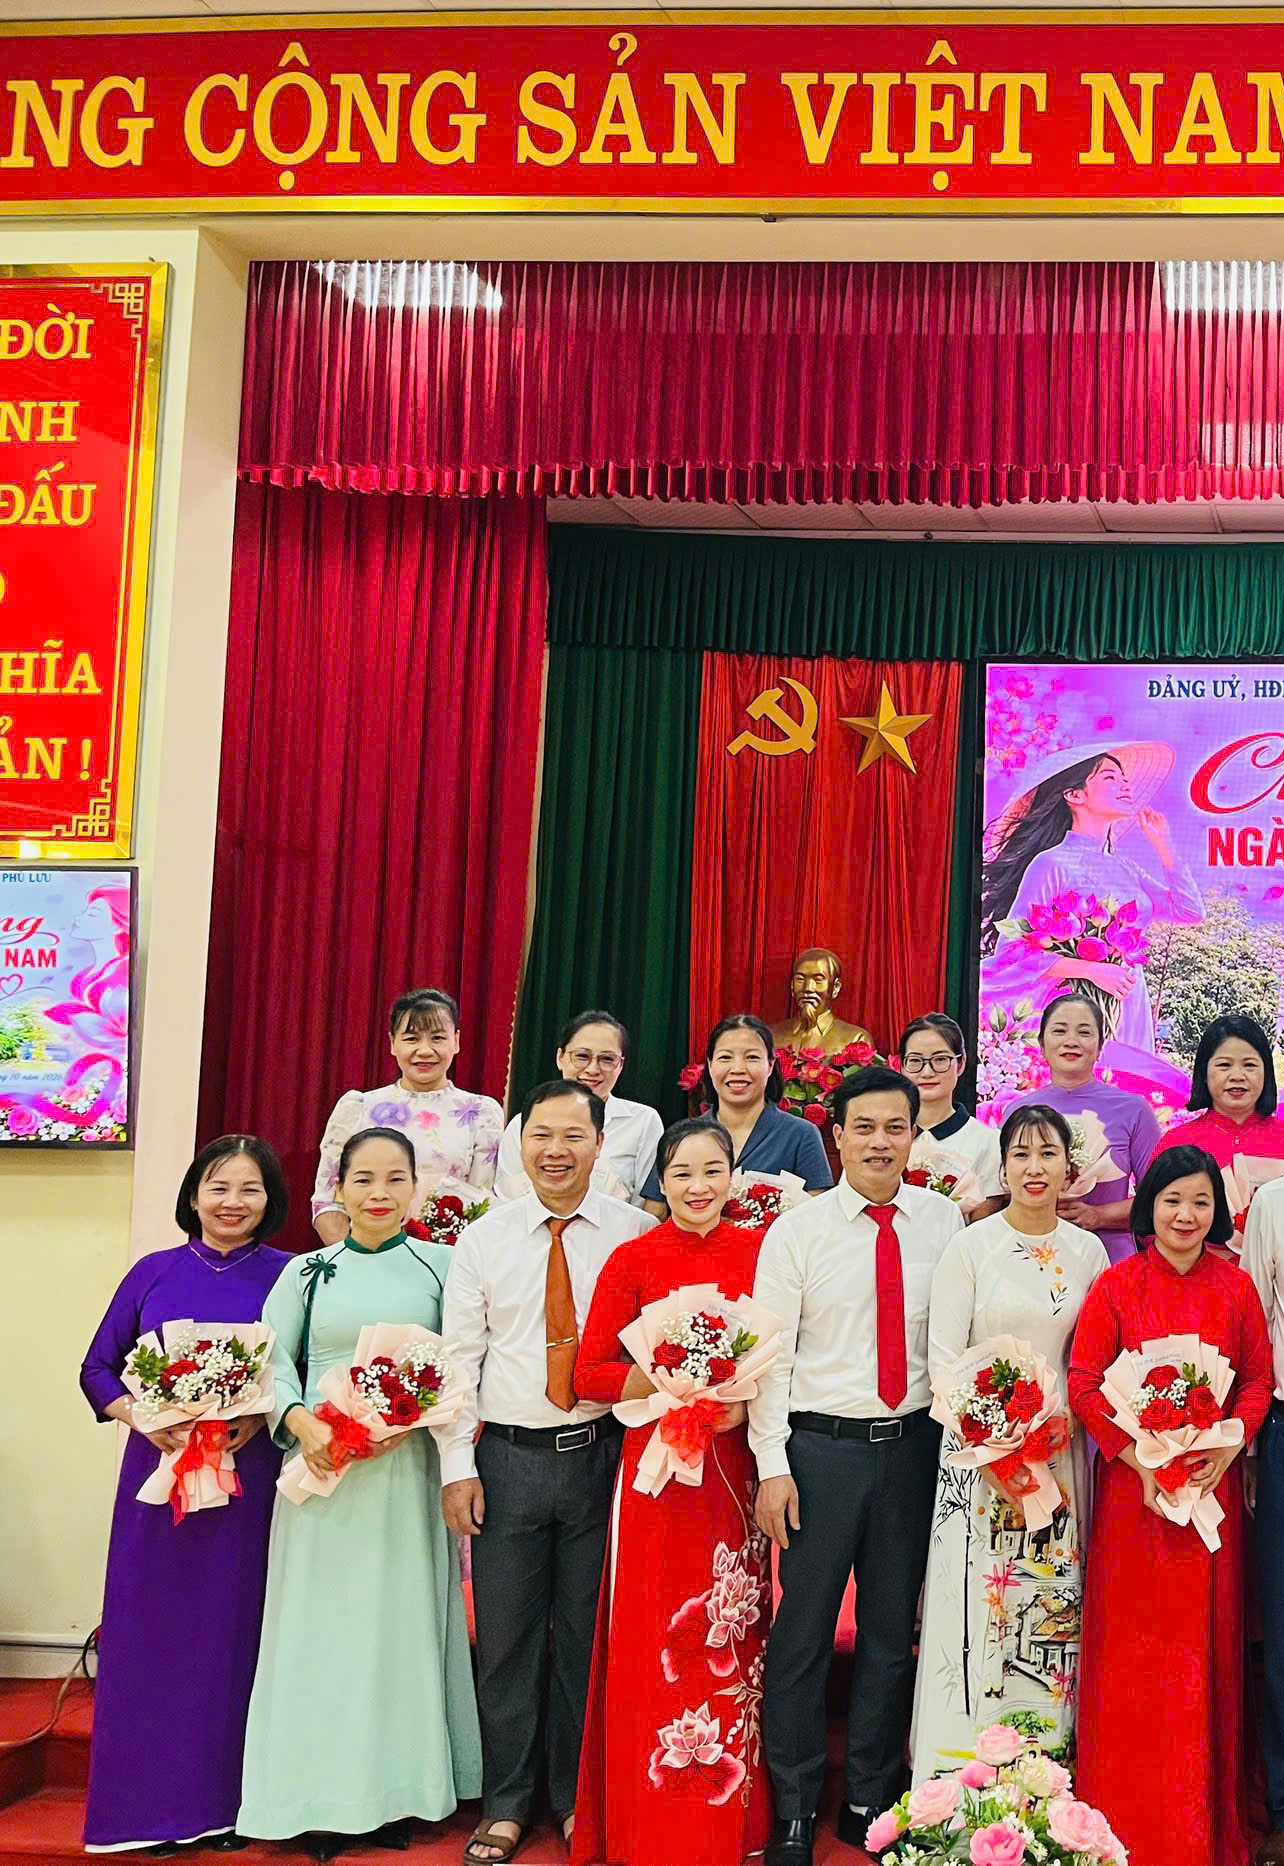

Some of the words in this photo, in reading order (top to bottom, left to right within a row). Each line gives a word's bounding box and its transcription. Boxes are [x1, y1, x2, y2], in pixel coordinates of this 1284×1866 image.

[184, 43, 487, 191] CỘNG
[517, 33, 747, 166] SẢN
[781, 40, 1047, 191] VIỆT
[0, 303, 94, 360] ĐỜI
[1148, 674, 1206, 698] ĐẢNG
[1213, 674, 1246, 701] UỶ,
[5, 948, 57, 968] NAM
